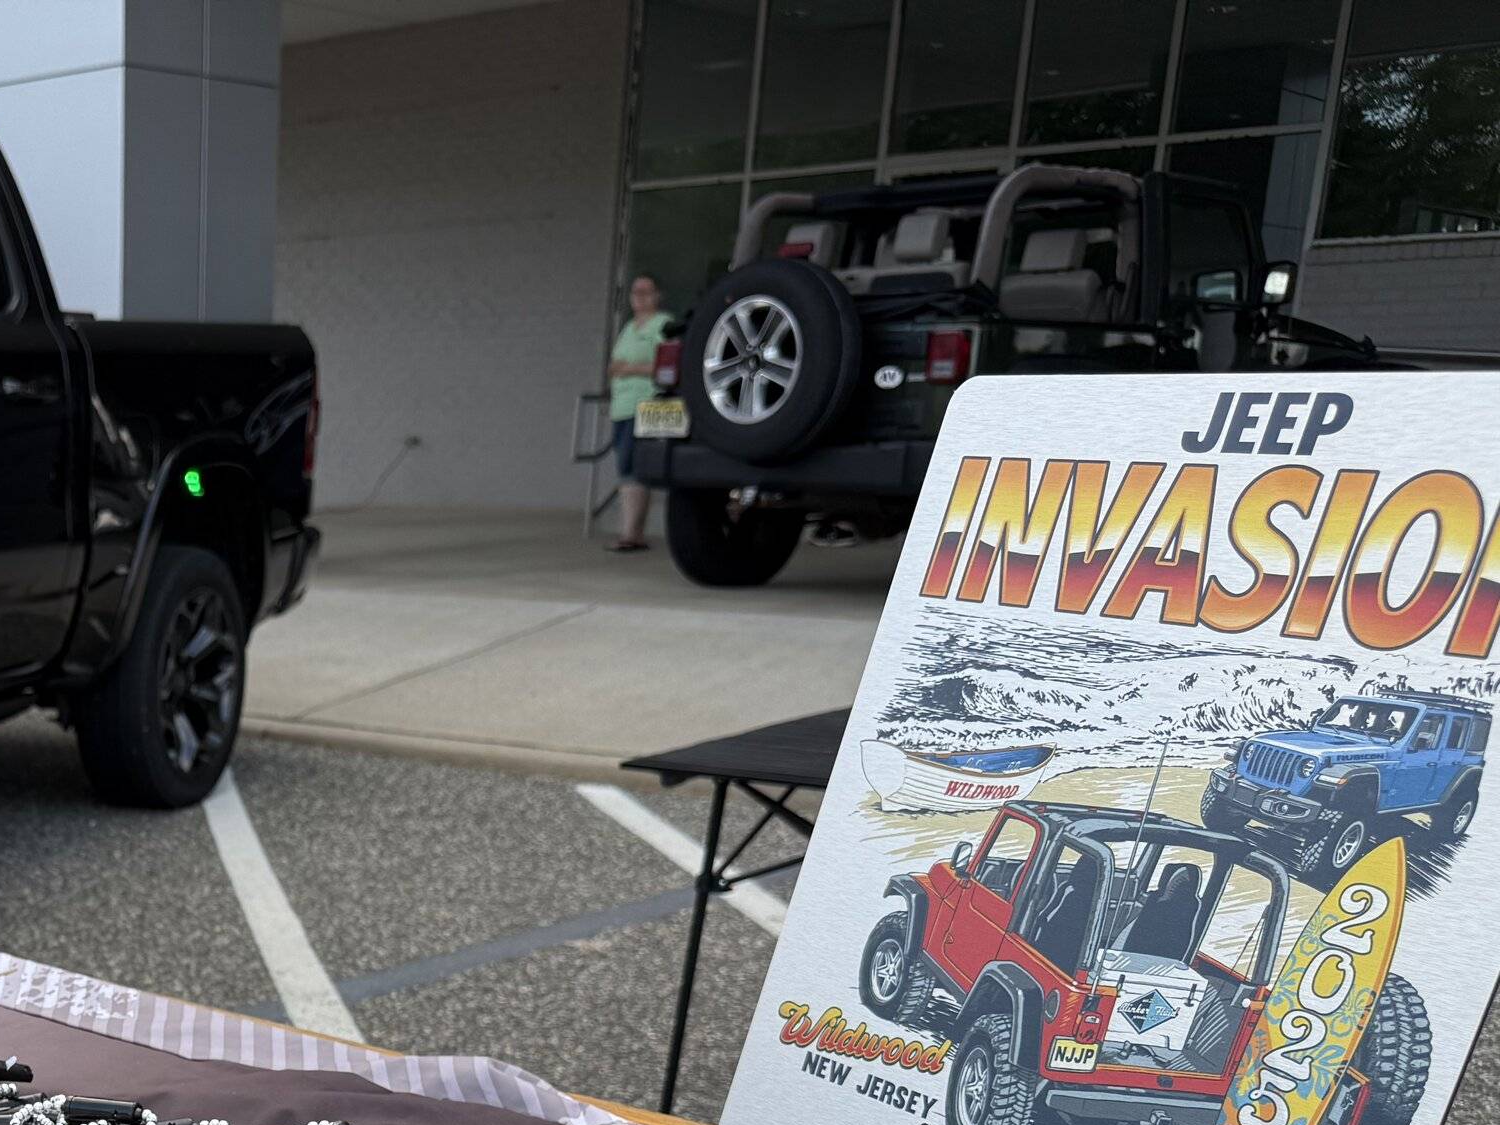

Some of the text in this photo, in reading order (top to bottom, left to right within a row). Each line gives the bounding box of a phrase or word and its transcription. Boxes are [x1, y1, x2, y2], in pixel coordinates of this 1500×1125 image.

[1181, 392, 1354, 456] JEEP
[1337, 753, 1385, 761] RUBICON
[944, 780, 1020, 799] WILDWOOD
[778, 1001, 952, 1075] Wildwood
[1055, 1046, 1095, 1064] NJJP
[802, 1051, 938, 1119] NEW JERSEY
